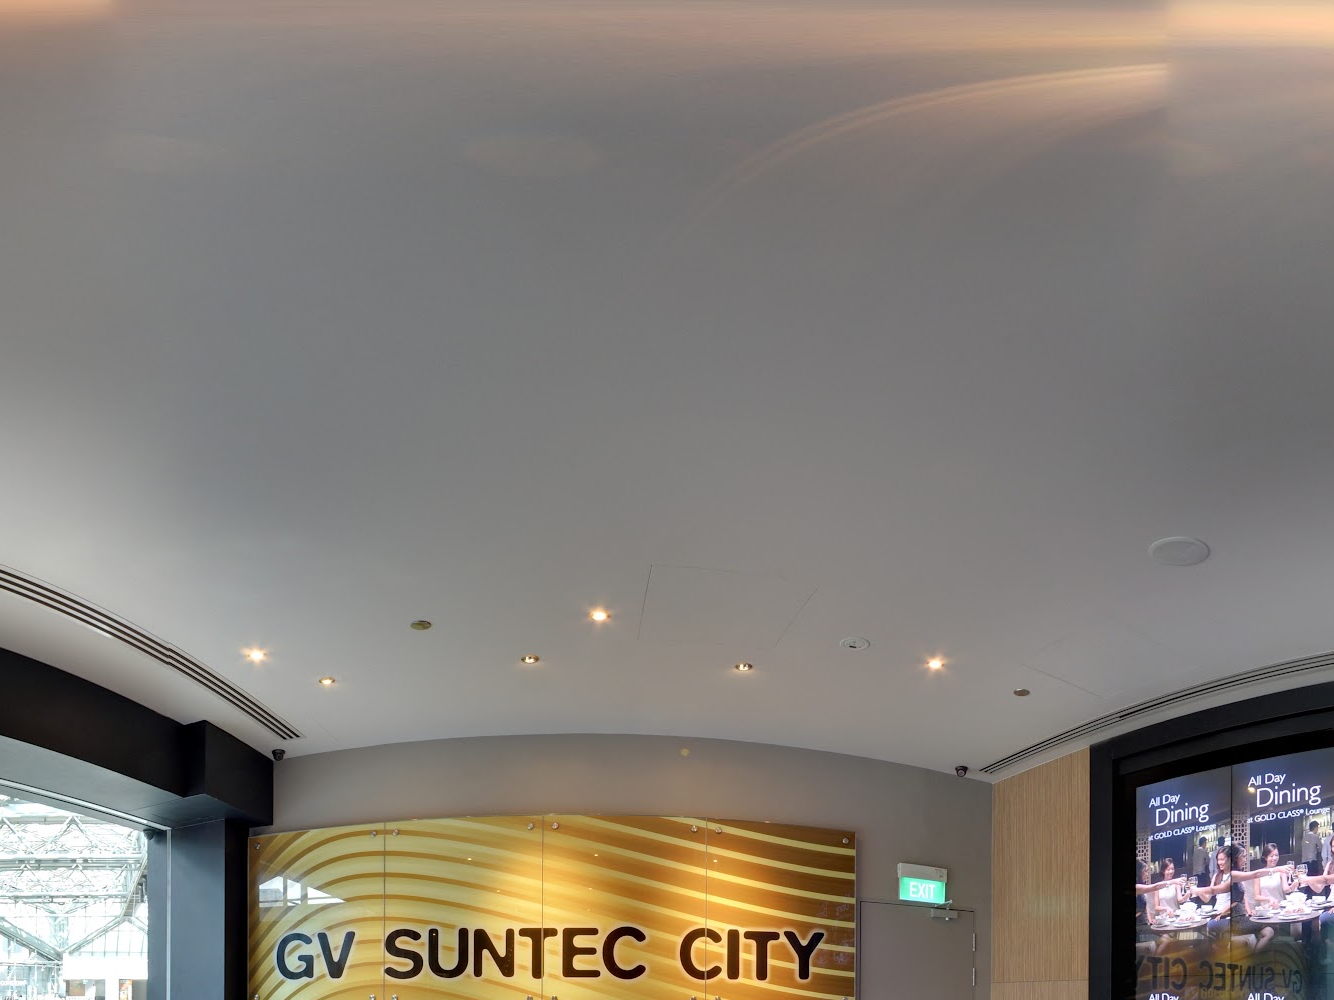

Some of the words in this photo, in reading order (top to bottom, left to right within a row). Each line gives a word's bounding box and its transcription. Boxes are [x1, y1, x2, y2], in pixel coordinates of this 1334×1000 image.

[1248, 775, 1262, 787] All
[1264, 773, 1286, 785] Day
[1149, 796, 1160, 808] All
[1162, 794, 1180, 806] Day
[1256, 783, 1322, 807] Dining
[1155, 803, 1209, 827] Dining
[1254, 812, 1276, 823] GOLD
[1305, 807, 1330, 817] Lounge
[1154, 830, 1172, 841] GOLD
[1195, 823, 1217, 833] Lounge
[909, 881, 936, 900] EXIT
[274, 929, 356, 981] GV
[383, 925, 646, 981] SUNTEC
[679, 928, 826, 981] CITY
